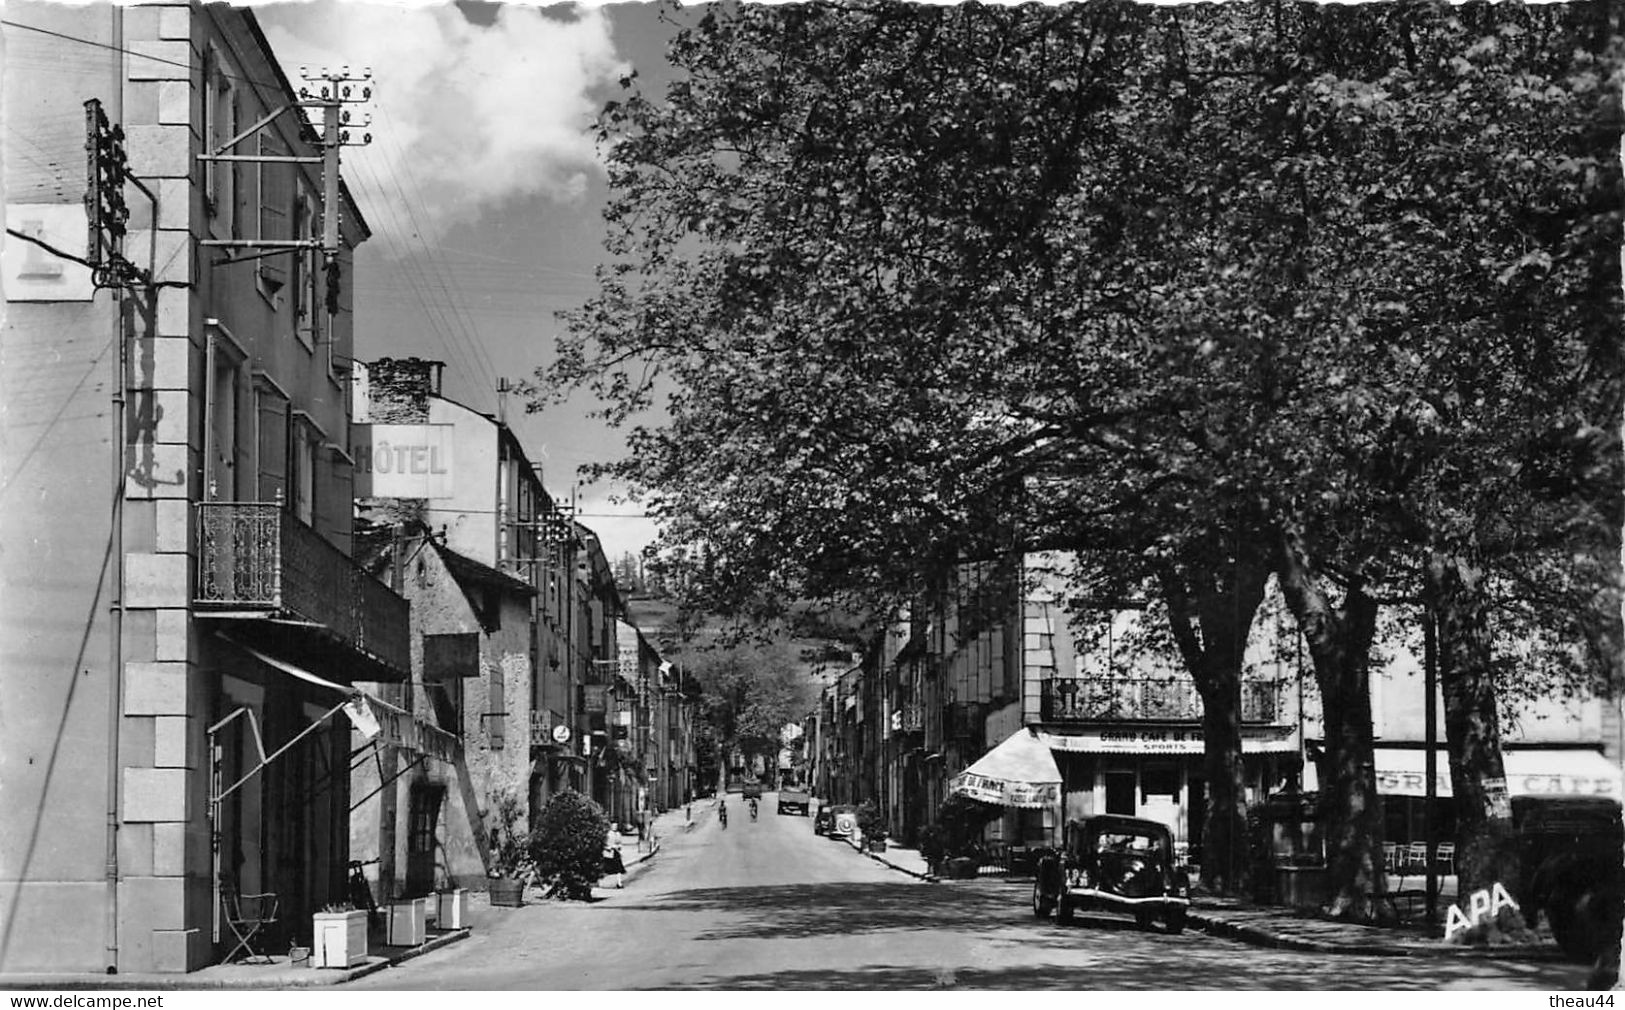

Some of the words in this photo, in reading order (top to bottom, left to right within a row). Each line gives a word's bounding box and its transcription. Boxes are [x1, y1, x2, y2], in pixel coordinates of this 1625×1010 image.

[354, 441, 447, 474] HÔTEL
[1100, 731, 1137, 742] GRAND
[1174, 731, 1187, 742] DE
